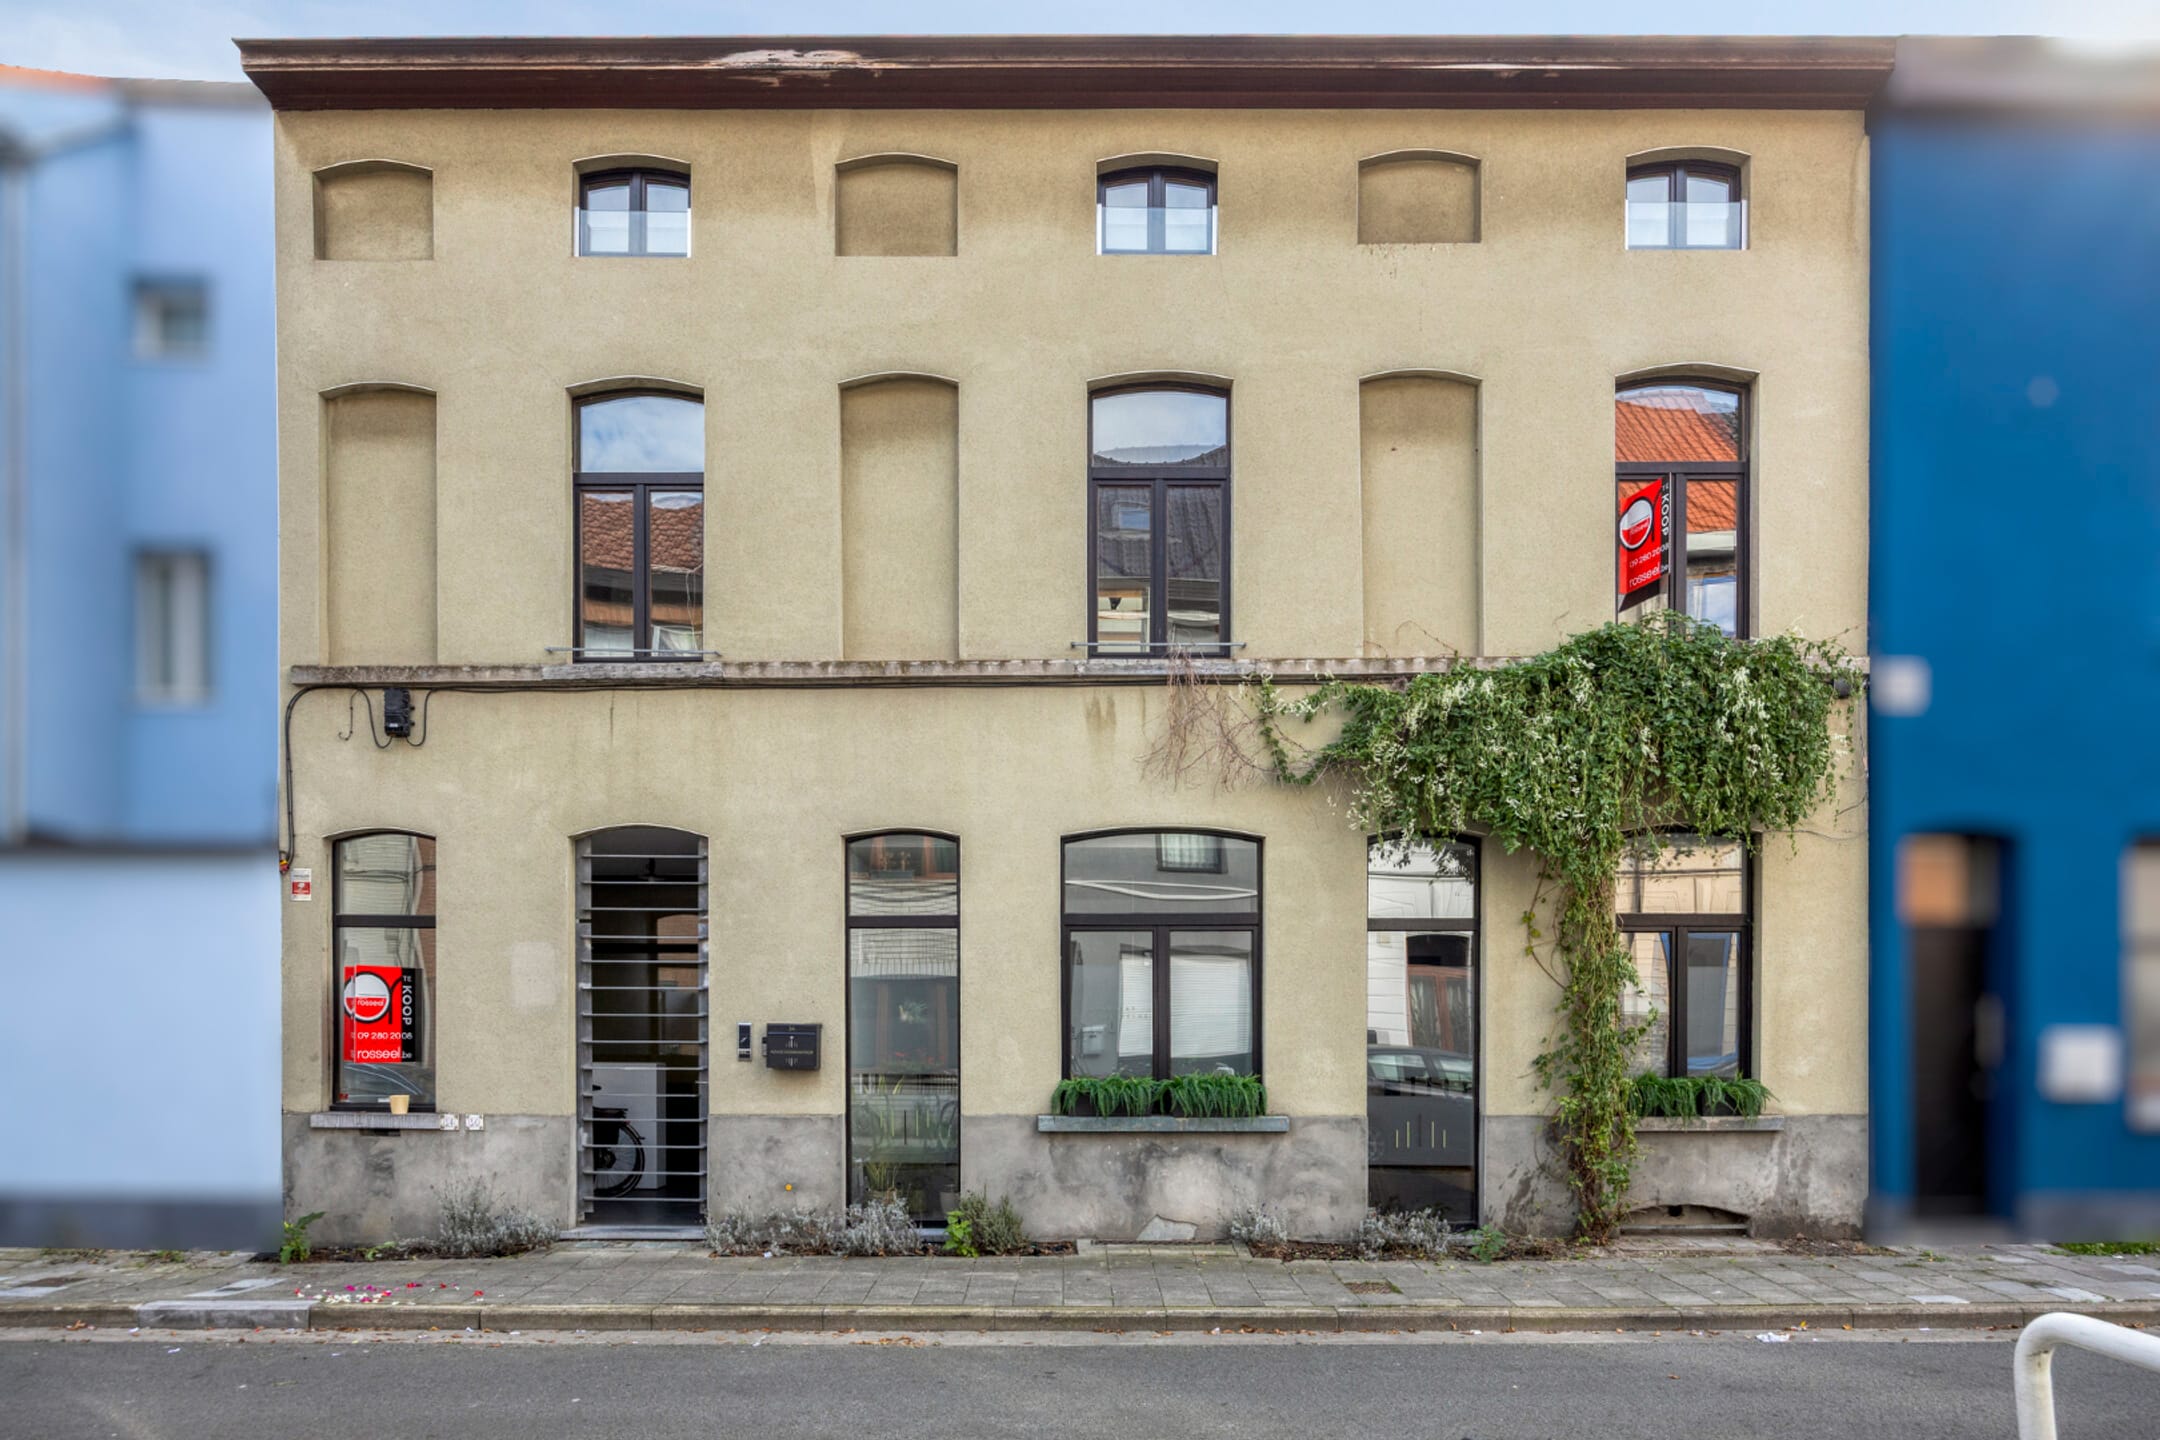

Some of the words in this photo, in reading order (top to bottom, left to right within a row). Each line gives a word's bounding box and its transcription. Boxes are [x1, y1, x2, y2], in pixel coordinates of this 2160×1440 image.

[1661, 493, 1669, 536] KOOP
[402, 985, 412, 1026] KOOP
[357, 1032, 369, 1040] 09
[371, 1031, 388, 1040] 280
